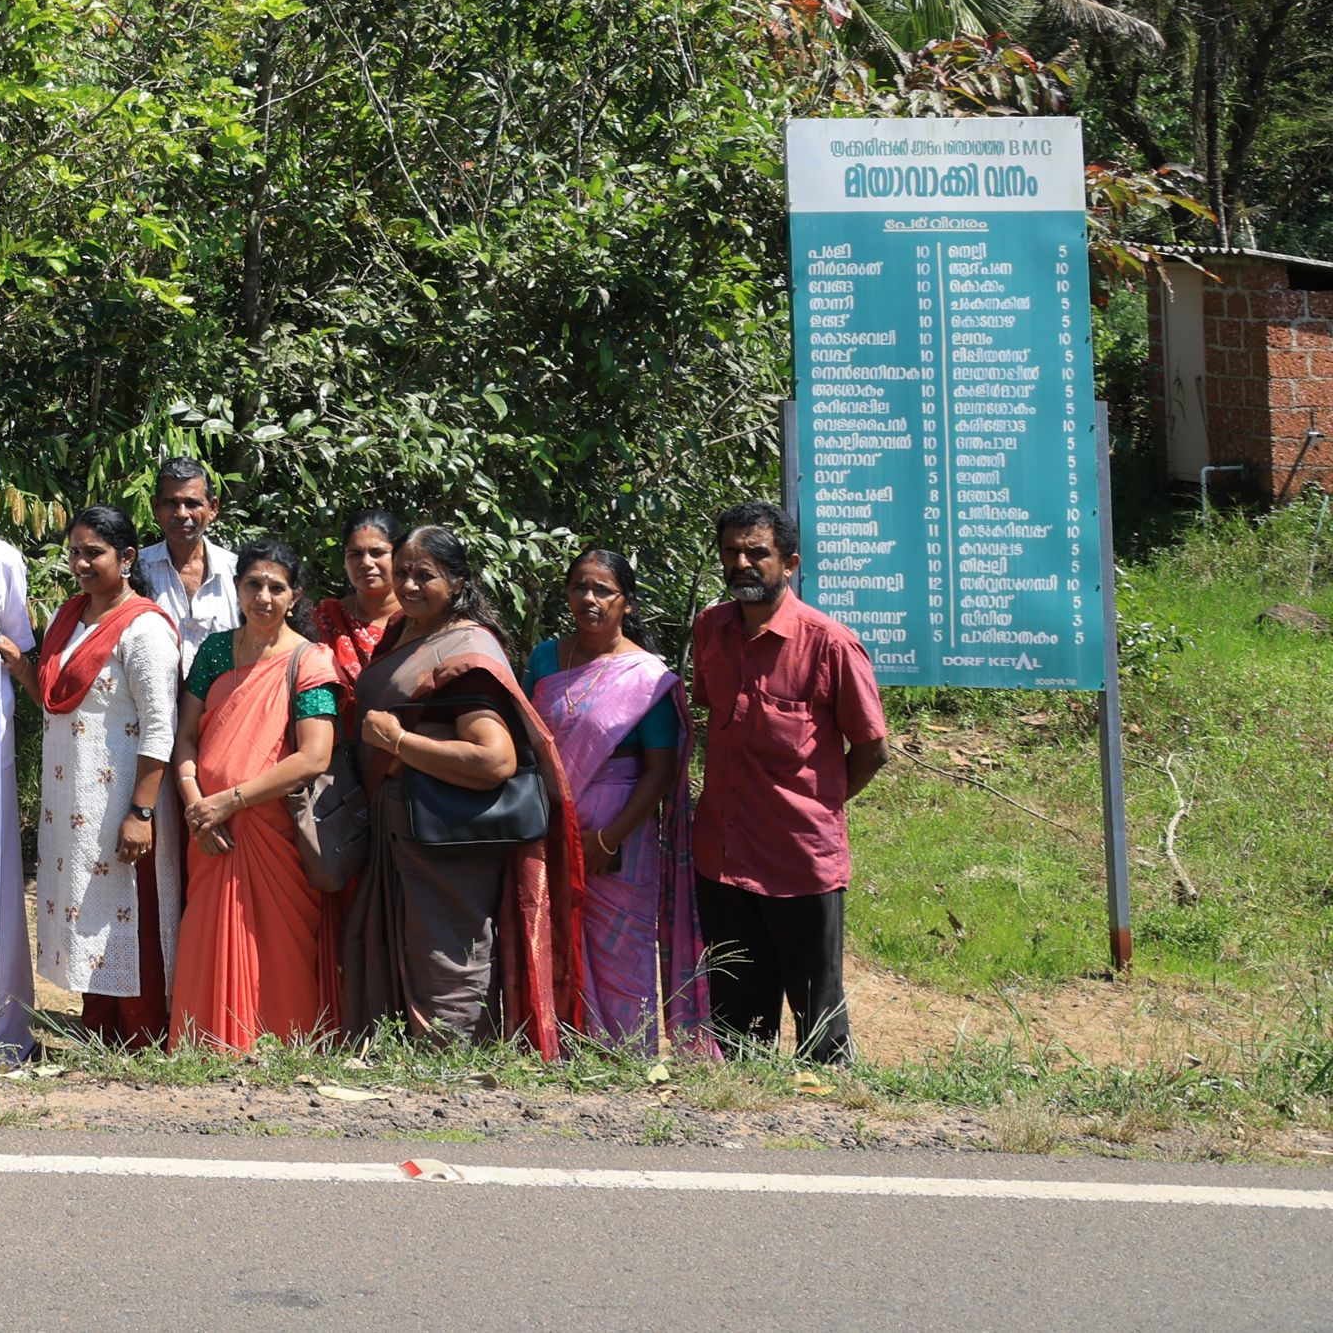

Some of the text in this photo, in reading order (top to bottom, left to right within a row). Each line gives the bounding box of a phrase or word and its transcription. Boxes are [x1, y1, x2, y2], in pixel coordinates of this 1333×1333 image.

[844, 162, 1038, 198] മിയാവാക്കി വനം
[930, 216, 989, 229] വിവരം
[808, 243, 930, 258] പുളി 10
[948, 242, 1068, 260] നെല്ലി 5
[808, 260, 930, 275] നീർമരുത് 10
[1056, 262, 1069, 275] 10
[808, 281, 931, 293] വേങ്ങ 10
[949, 279, 1069, 293] കൊക്കം 10
[809, 295, 932, 310] താന്നി 10
[1061, 298, 1070, 310] 5
[810, 313, 932, 327] ഉങ്ങ് 10
[1062, 315, 1070, 328] 5
[810, 330, 932, 345] കൊടുവേലി 10
[951, 332, 1071, 345] ഉലവം 10
[811, 347, 933, 362] വേപ്പ് 10
[1065, 350, 1074, 362] 5
[921, 367, 934, 379] 10
[1062, 367, 1074, 380] 10
[812, 384, 935, 397] അശോകം 10
[953, 383, 1074, 398] കുളിർമാവ് 5
[812, 399, 935, 414] കറിവേപ്പില 10
[1066, 403, 1075, 415] 5
[923, 420, 936, 431] 10
[1063, 420, 1075, 432] 10
[923, 437, 937, 449] 10
[1067, 437, 1075, 450] 5
[814, 452, 937, 466] വയനാവ് 10
[956, 452, 1076, 468] അത്തി 5
[814, 469, 938, 484] മാവ് 5
[956, 470, 1077, 485] ഇത്തി 5
[815, 486, 939, 502] കുടംപുളി 8
[1070, 491, 1078, 503] 5
[816, 504, 940, 519] ഞാവൽ 20
[1067, 508, 1080, 521] 10
[816, 521, 939, 537] ഇലഞ്ഞി 11
[1067, 526, 1080, 538] 10
[817, 538, 941, 555] മണിമരുത് 10
[1071, 543, 1080, 556] 5
[818, 556, 942, 572] കുമിഴ് 10
[959, 556, 1080, 575] തിപ്പല്ലി 5
[818, 573, 943, 592] മധുരനെല്ലി 12
[1067, 578, 1080, 591] 10
[818, 590, 943, 607] വെട്ടി 10
[960, 594, 1082, 609] കശാവ് 5
[829, 611, 944, 625] ന്ദനവേമ്പ് 10
[1073, 614, 1083, 627] 3
[933, 630, 942, 642] 5
[961, 627, 1084, 644] പാരിജാതകം 5
[941, 652, 1042, 670] DORF KETAL
